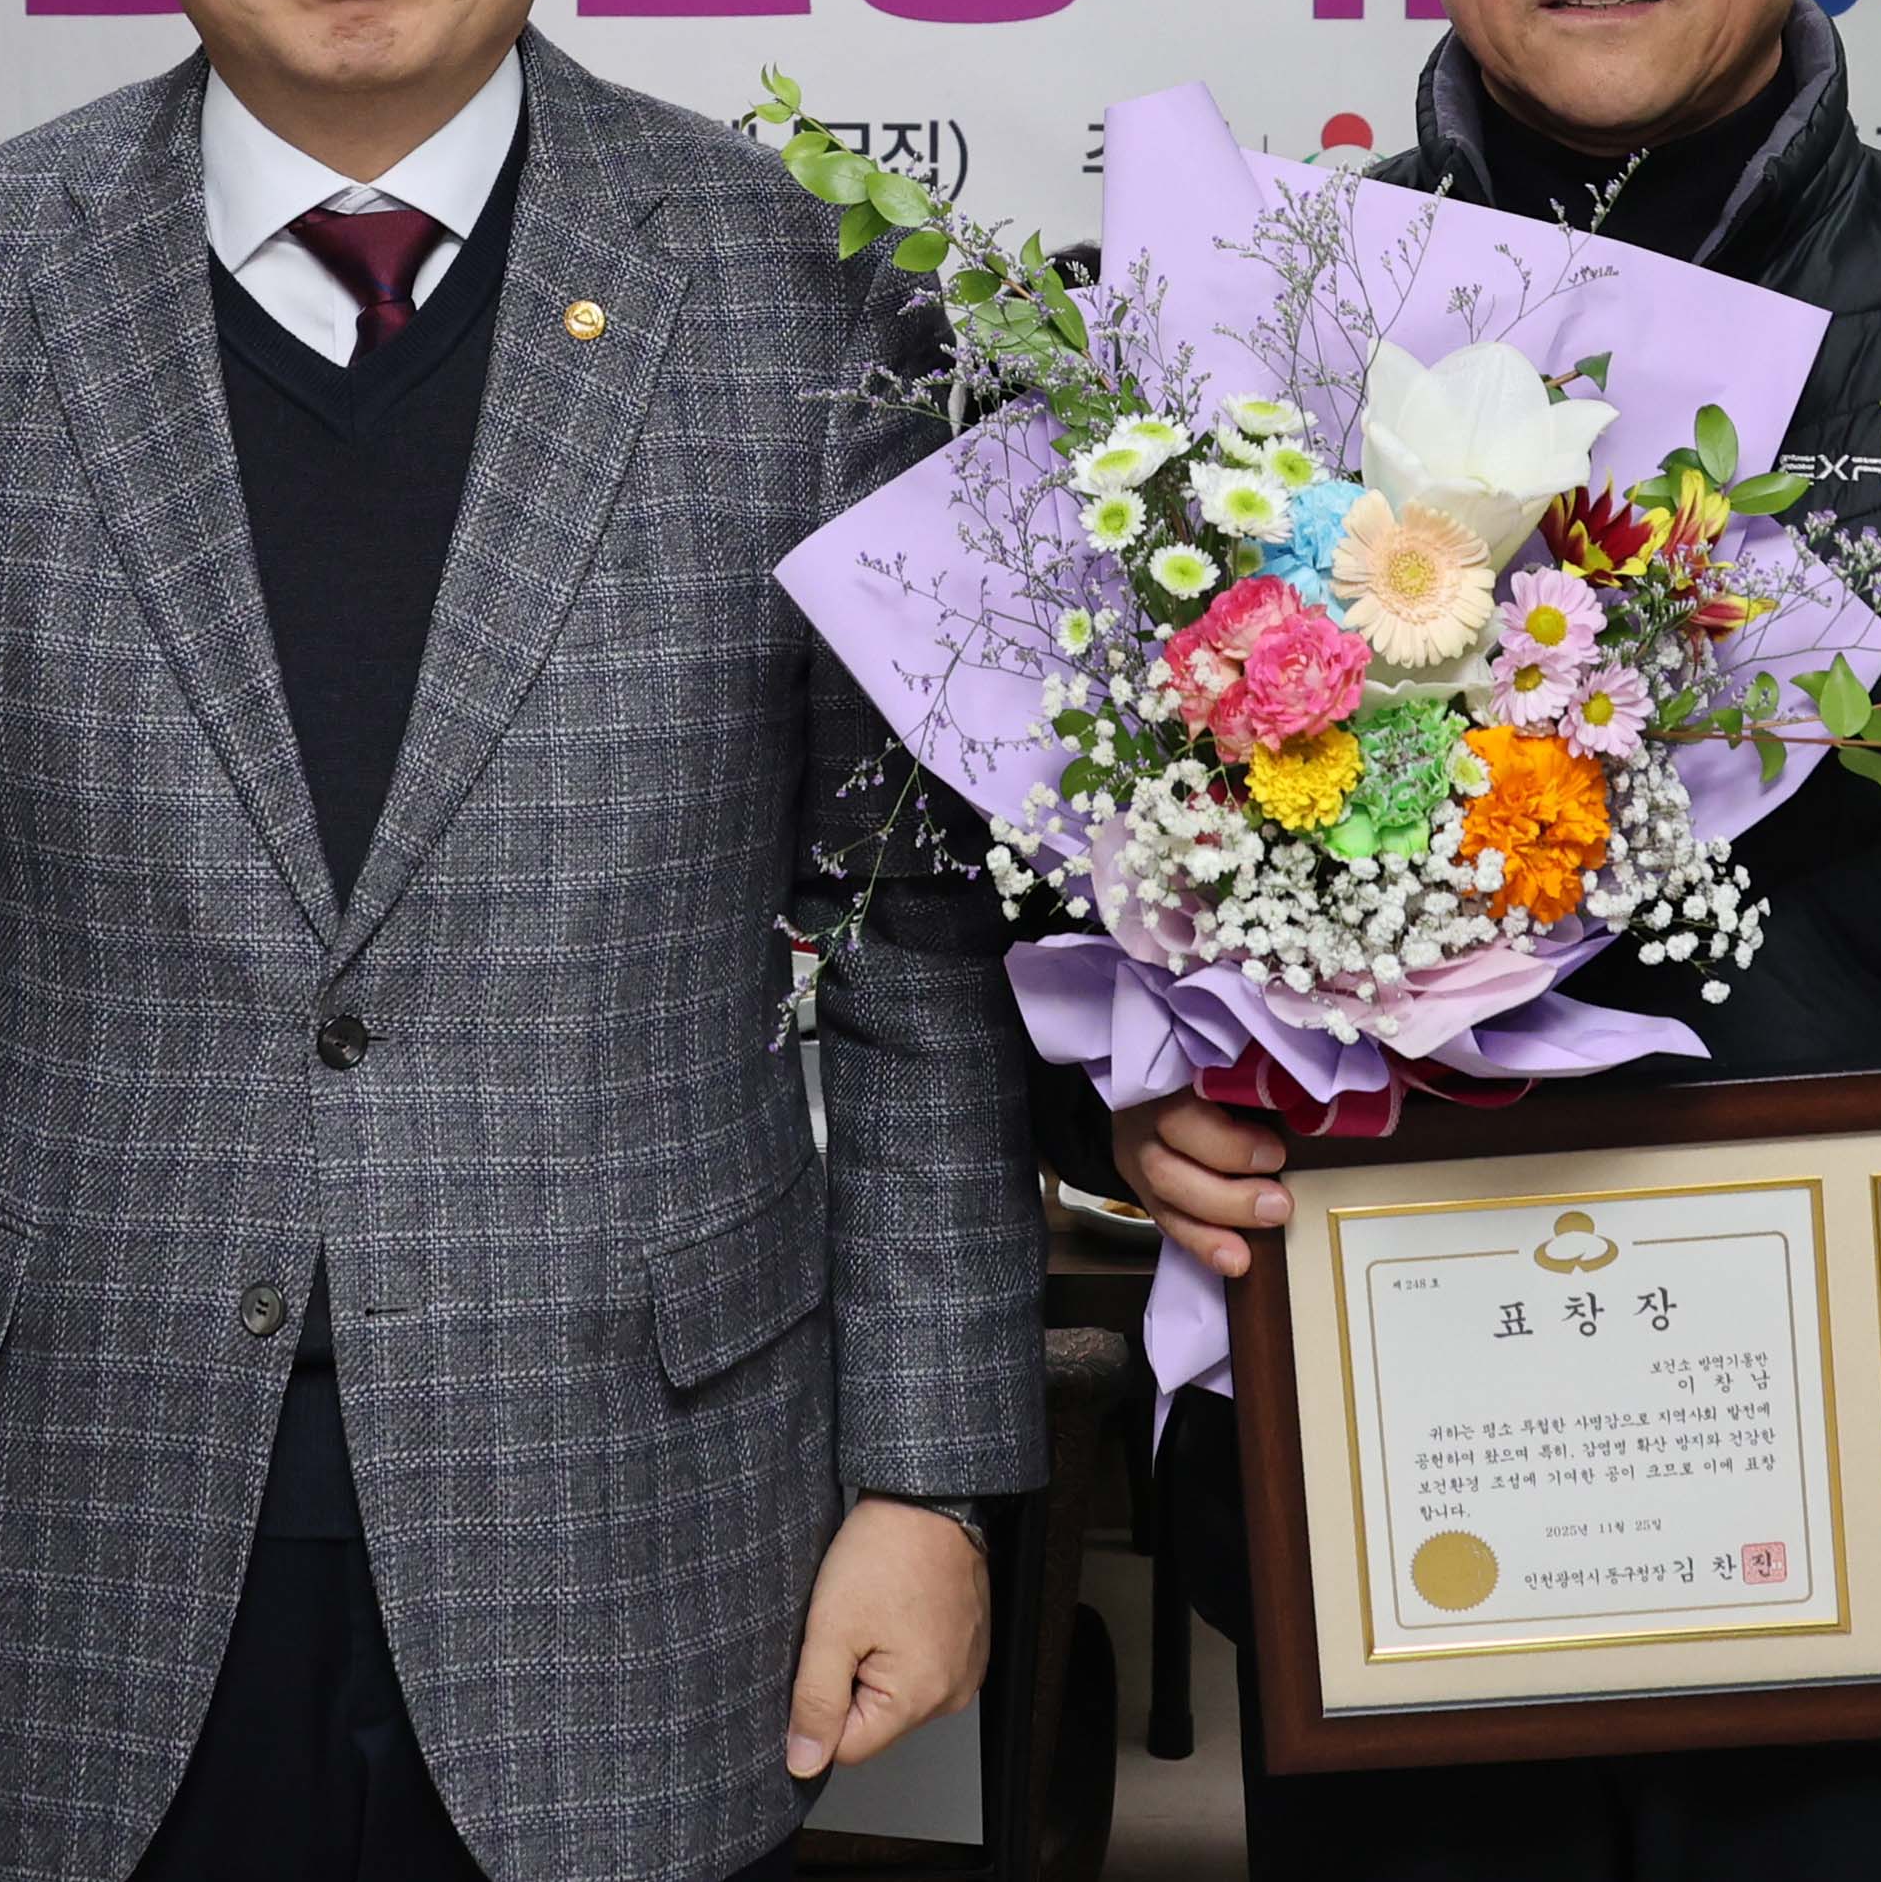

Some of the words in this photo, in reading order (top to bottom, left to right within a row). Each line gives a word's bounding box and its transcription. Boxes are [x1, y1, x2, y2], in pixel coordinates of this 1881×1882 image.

[1650, 1357, 1692, 1375] 보건소
[1429, 1423, 1475, 1442] 귀하는
[1482, 1421, 1514, 1439] 평소
[1574, 1412, 1651, 1432] 사명감으로
[1658, 1405, 1717, 1425] 지역사회
[1726, 1401, 1771, 1422] 발전에
[1414, 1449, 1475, 1471] 공헌하여
[1485, 1445, 1529, 1465] 왔으며
[1637, 1435, 1668, 1454] 확산
[1674, 1431, 1722, 1452] 방지와
[1729, 1426, 1776, 1448] 건강한
[1418, 1474, 1479, 1495] 보건환경
[1490, 1471, 1537, 1490] 조성에
[1547, 1467, 1596, 1487] 기여한
[1605, 1463, 1635, 1484] 공이
[1645, 1461, 1694, 1479] 크므로
[1703, 1456, 1734, 1475] 이에
[1744, 1453, 1776, 1472] 표창
[1524, 1567, 1600, 1591] 인천광역시
[1605, 1563, 1667, 1586] 동구청장
